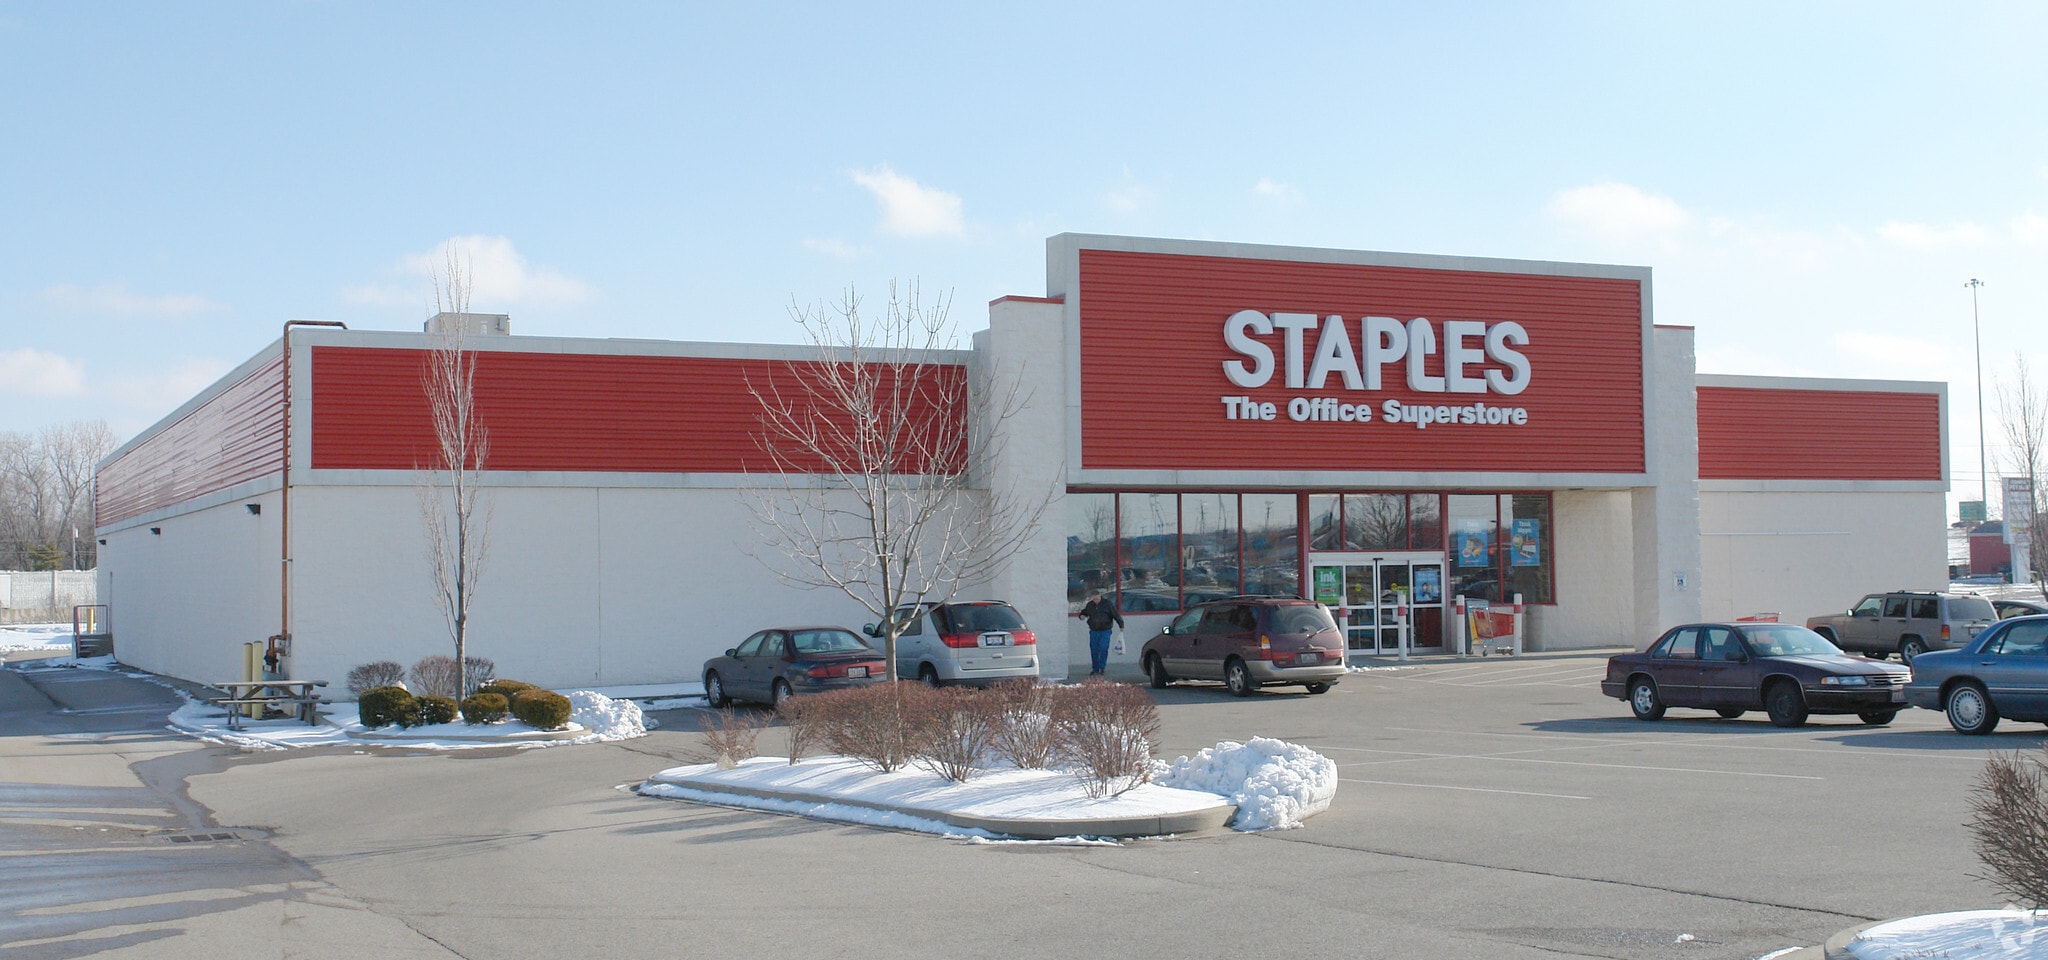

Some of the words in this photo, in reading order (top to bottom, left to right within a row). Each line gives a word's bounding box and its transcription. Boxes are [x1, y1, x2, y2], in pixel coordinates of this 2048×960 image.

[1222, 309, 1532, 395] STAPLES
[1221, 396, 1277, 420] The
[1288, 397, 1372, 423] Office
[1382, 399, 1528, 429] Superstore
[1320, 570, 1336, 583] ink
